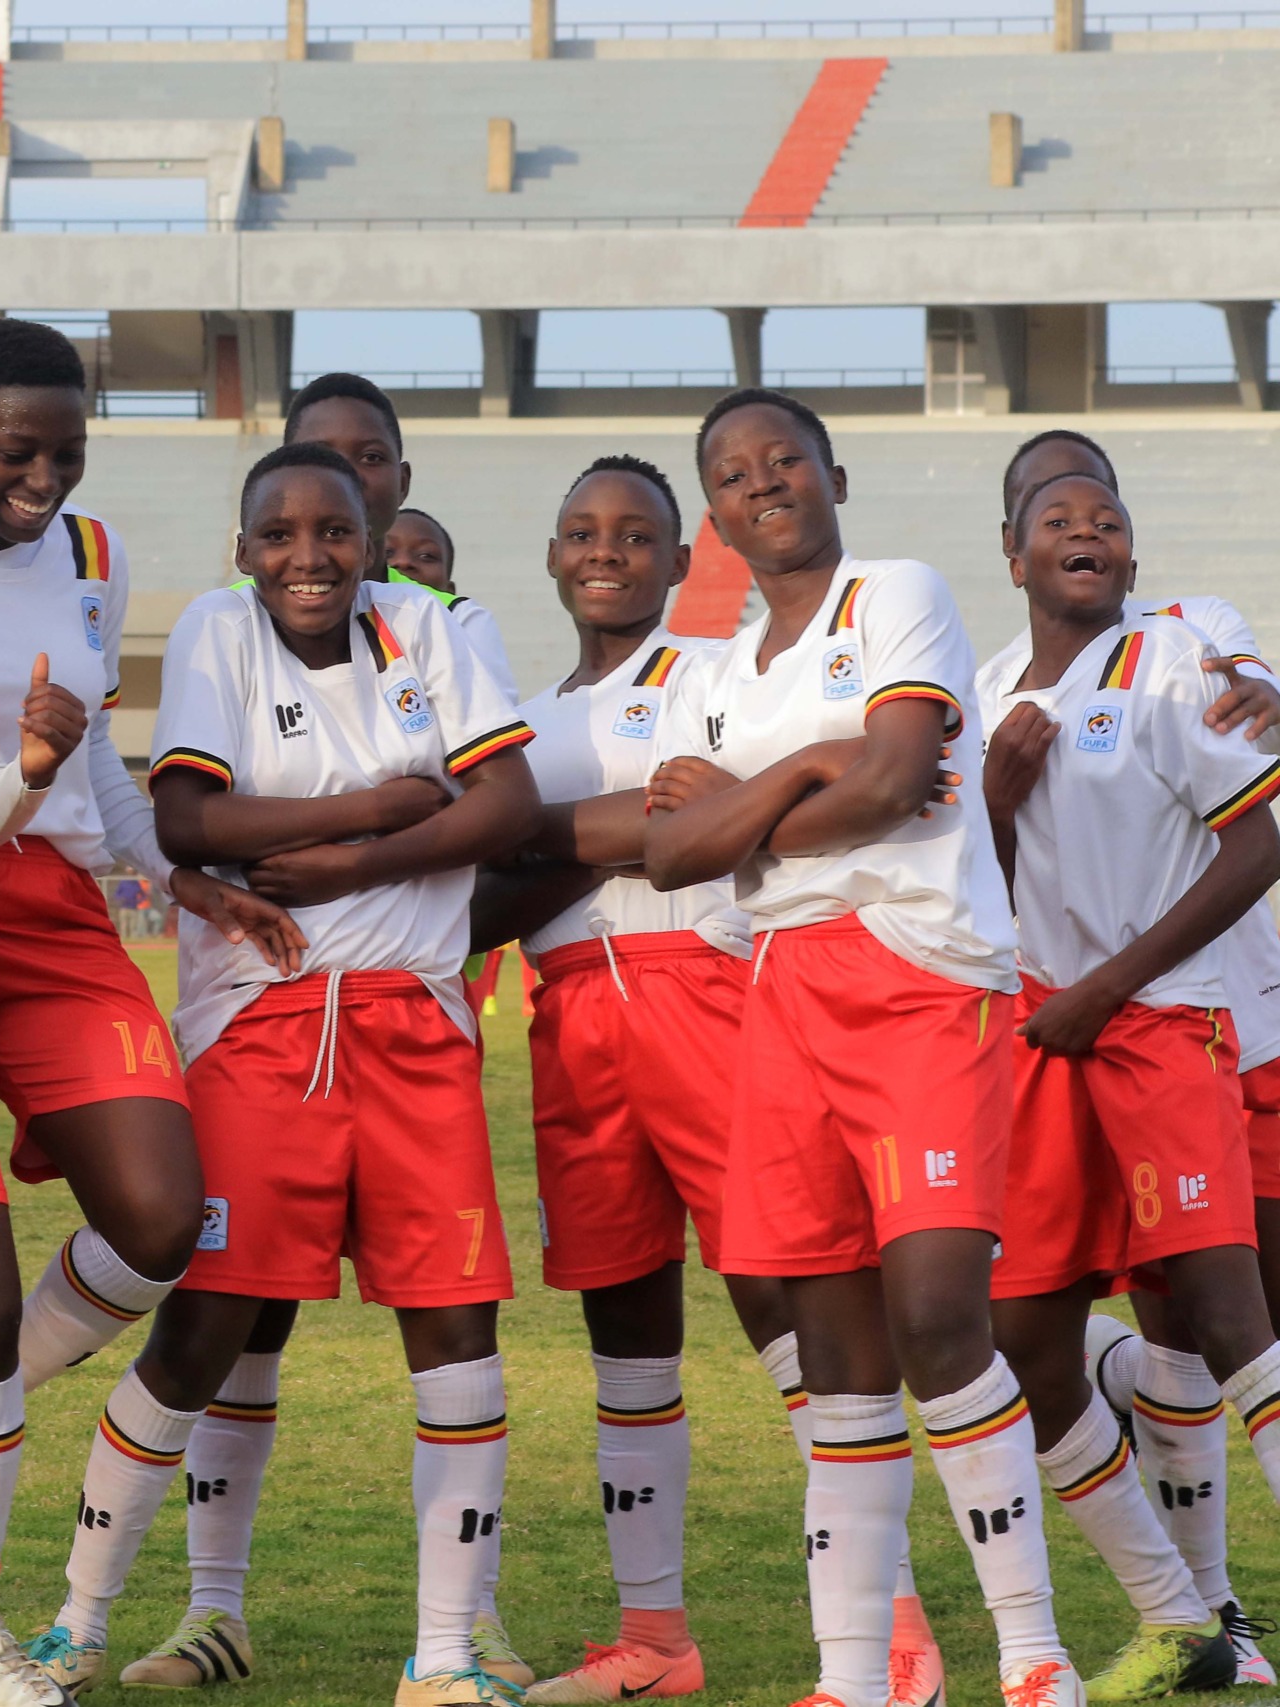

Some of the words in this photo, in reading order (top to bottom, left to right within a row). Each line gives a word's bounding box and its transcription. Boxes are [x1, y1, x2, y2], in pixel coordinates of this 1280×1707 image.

[1083, 739, 1108, 748] FUFA
[111, 1021, 172, 1078] 14
[872, 1134, 901, 1210] 11
[1132, 1161, 1162, 1229] 8
[1181, 1200, 1209, 1211] MAFRO
[199, 1236, 220, 1246] UFA
[455, 1207, 485, 1277] 7
